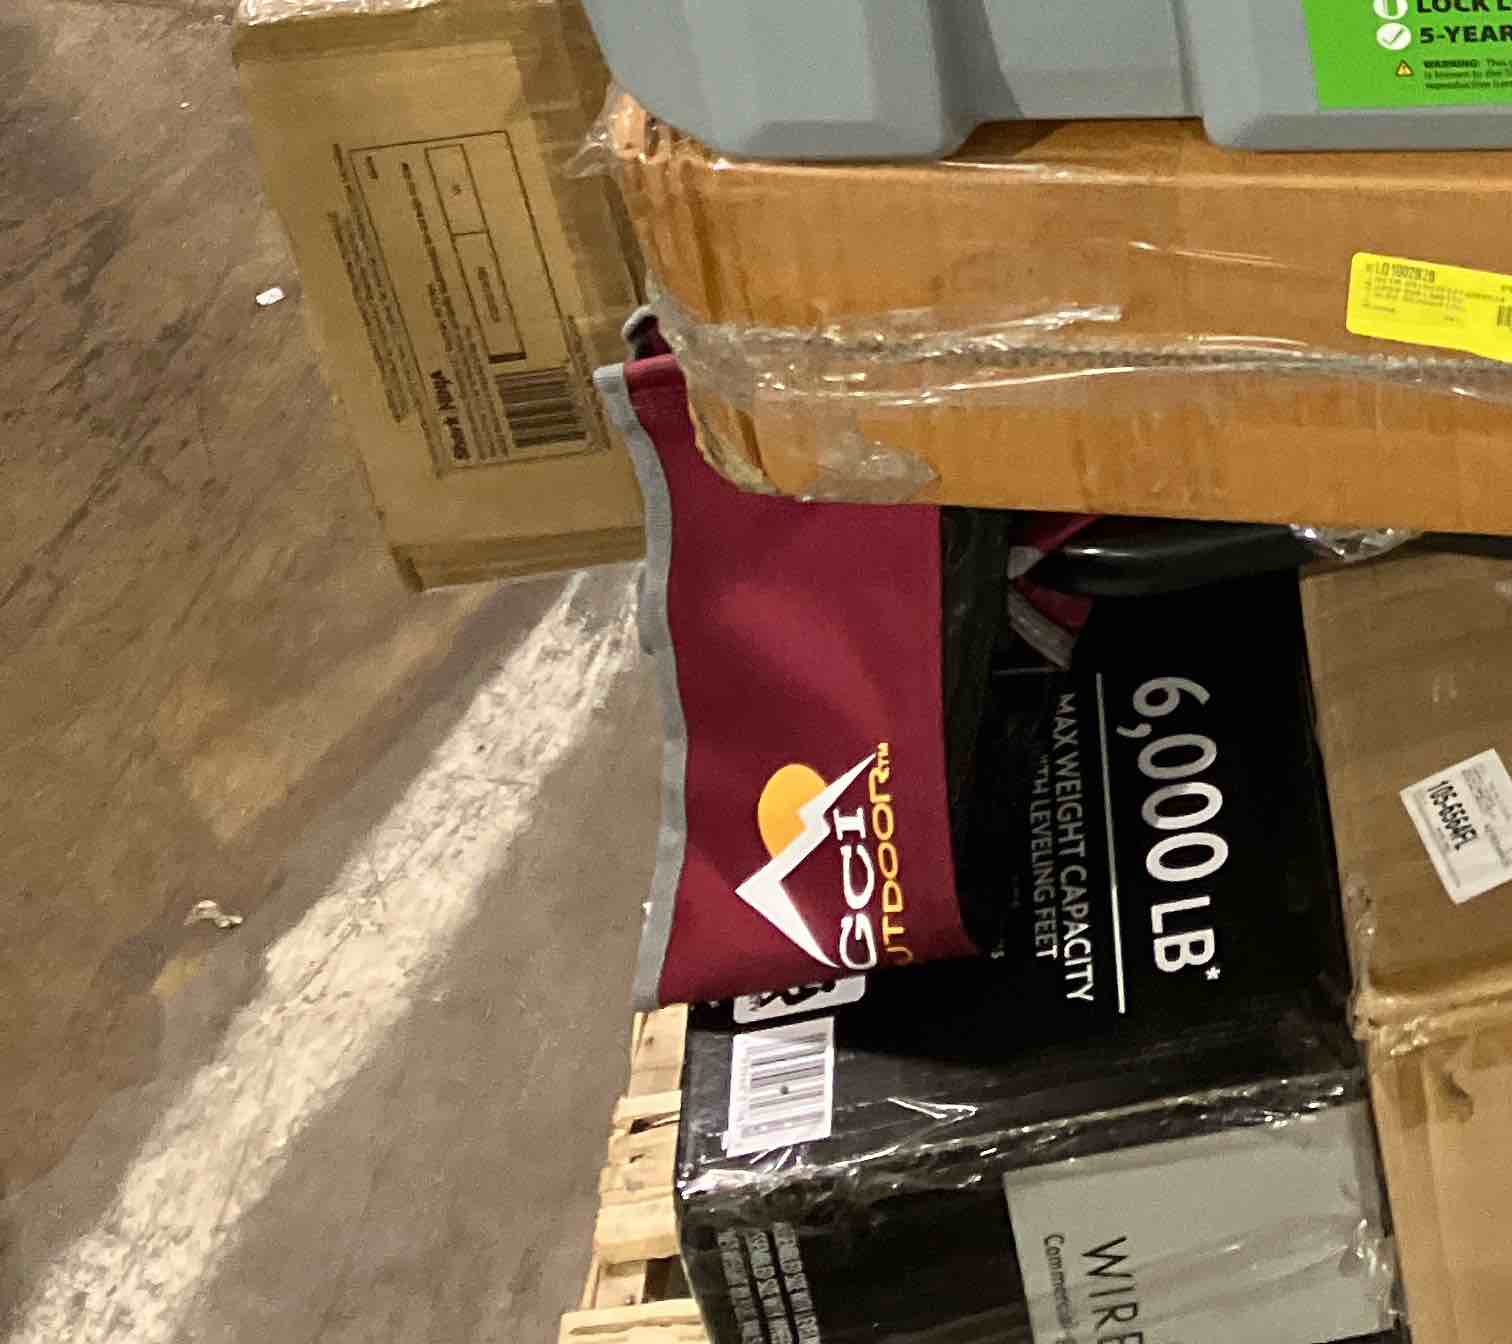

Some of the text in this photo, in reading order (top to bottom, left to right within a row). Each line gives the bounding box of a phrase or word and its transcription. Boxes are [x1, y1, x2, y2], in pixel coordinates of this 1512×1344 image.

[1031, 798, 1058, 914] LEVELING
[1051, 691, 1095, 1004] MAX WEIGHT CAPACITY
[1116, 676, 1230, 883] 6,000
[833, 807, 878, 971] GCI
[1035, 914, 1060, 960] FEET
